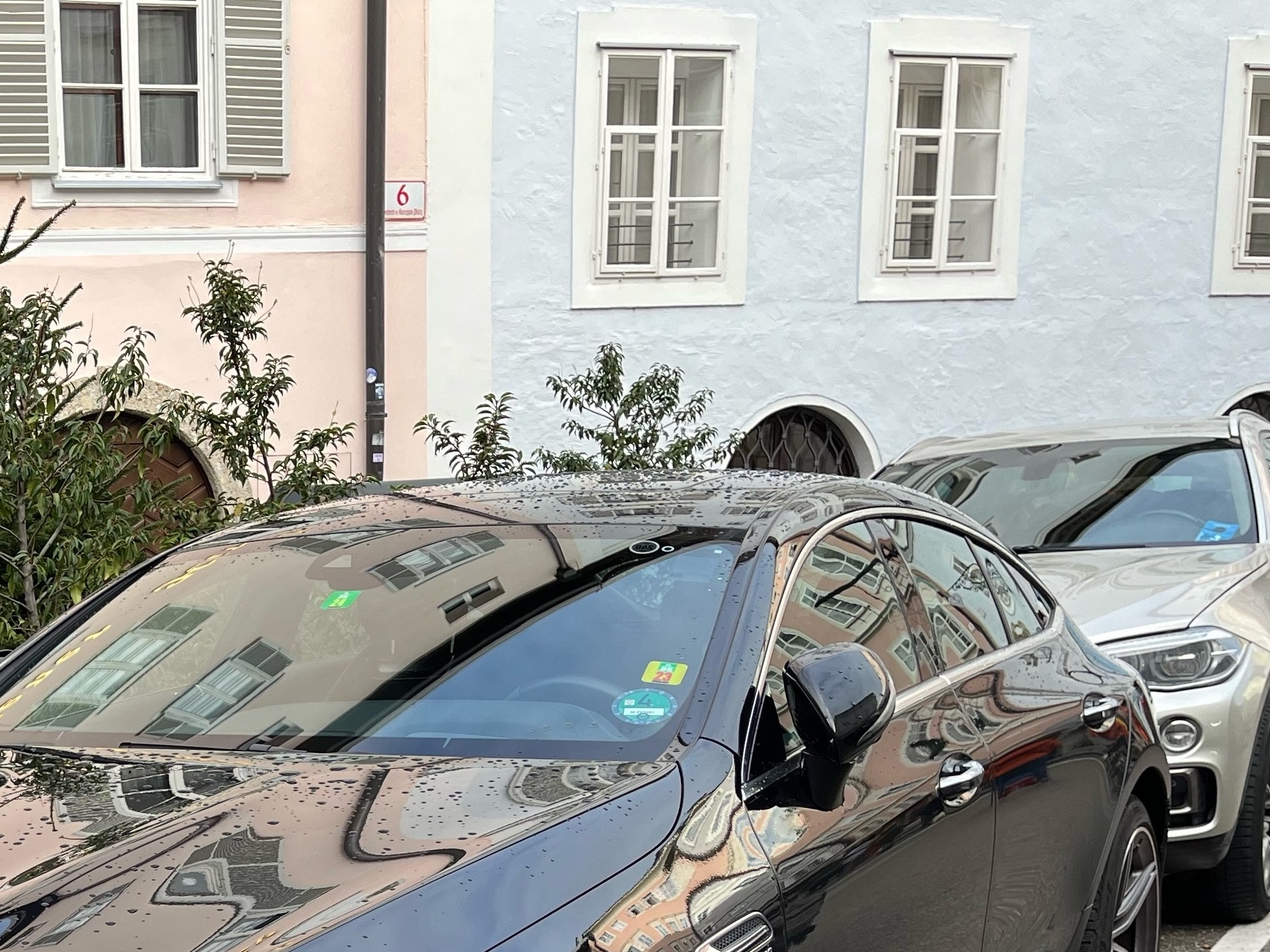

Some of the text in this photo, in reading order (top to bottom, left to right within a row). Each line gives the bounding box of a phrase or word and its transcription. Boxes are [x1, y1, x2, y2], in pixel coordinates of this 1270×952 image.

[396, 184, 410, 207] 6
[652, 671, 672, 682] 23
[637, 693, 653, 707] 4
